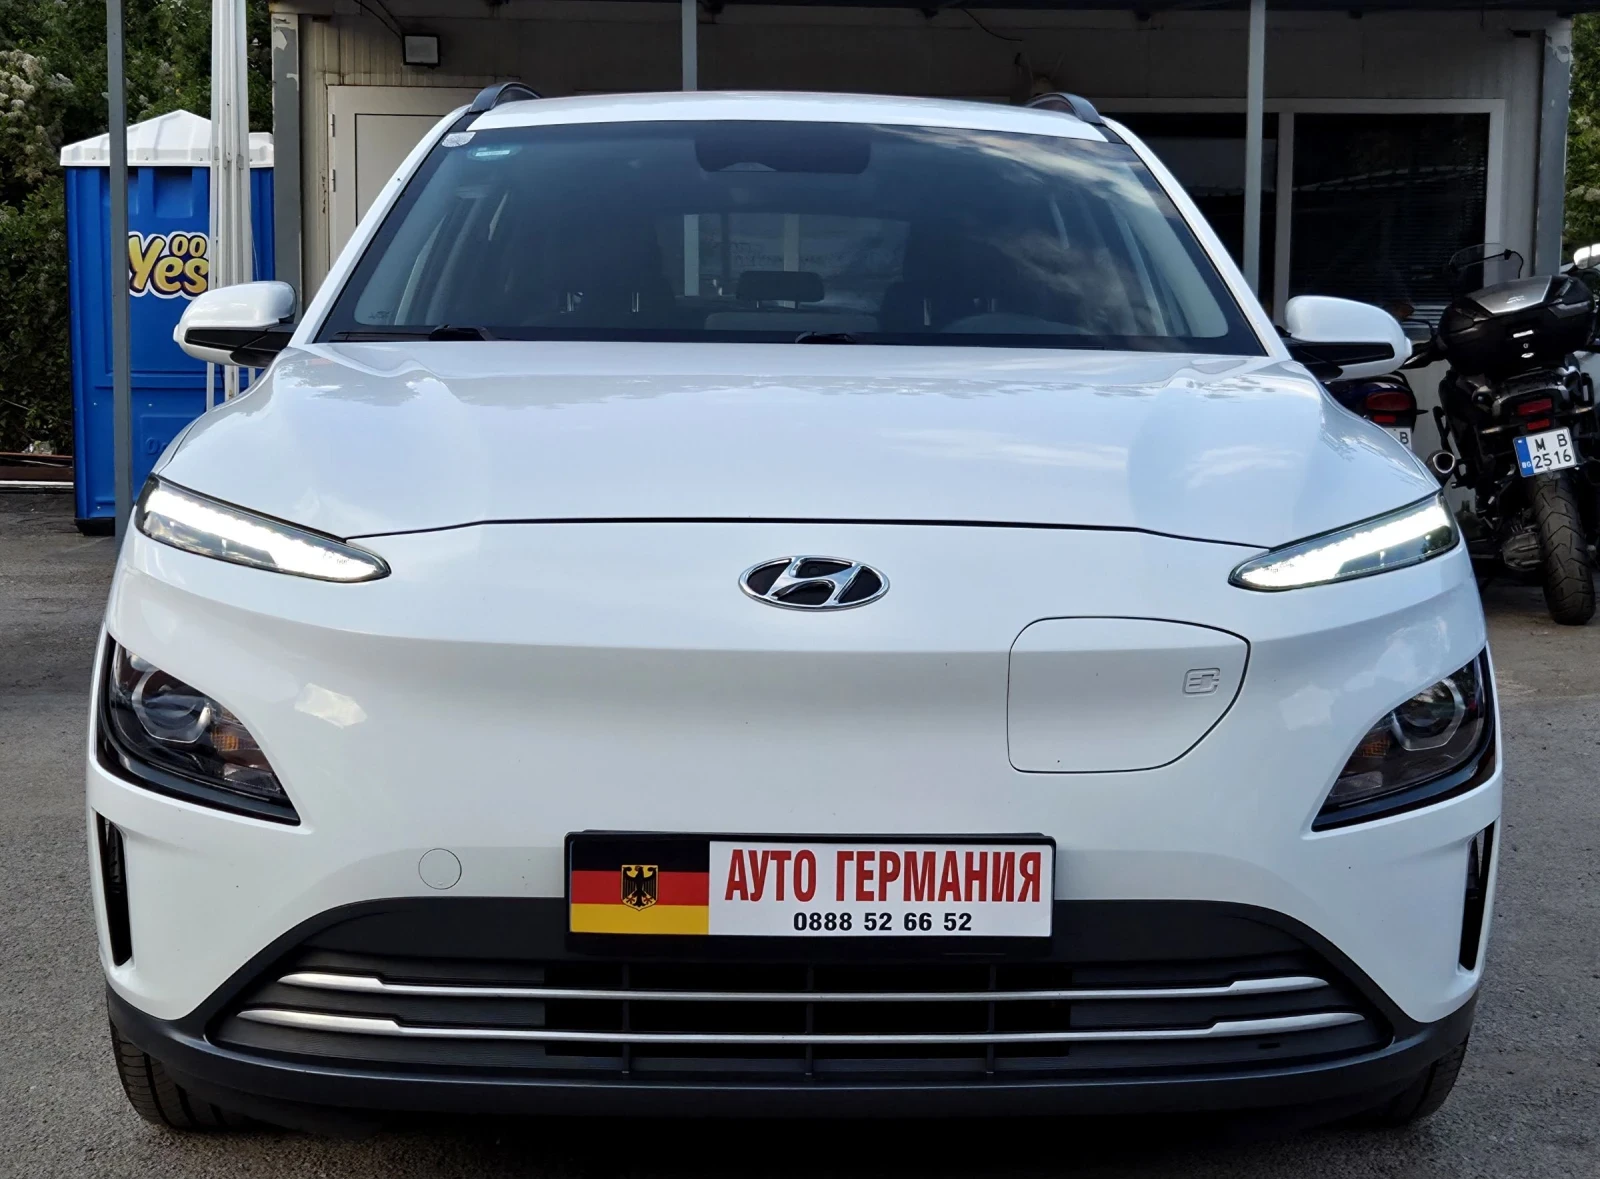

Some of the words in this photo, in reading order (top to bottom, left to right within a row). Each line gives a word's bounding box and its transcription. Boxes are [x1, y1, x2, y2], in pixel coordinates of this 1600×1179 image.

[1534, 437, 1546, 452] M
[1556, 433, 1568, 447] B
[1521, 461, 1532, 469] BG
[1532, 449, 1572, 469] 2516
[725, 848, 817, 903] АУТО
[835, 850, 1042, 904] ГЕРМАНИЯ
[793, 912, 853, 932] 0888
[863, 912, 893, 932] 52
[902, 912, 933, 932] 66
[943, 912, 972, 932] 52
